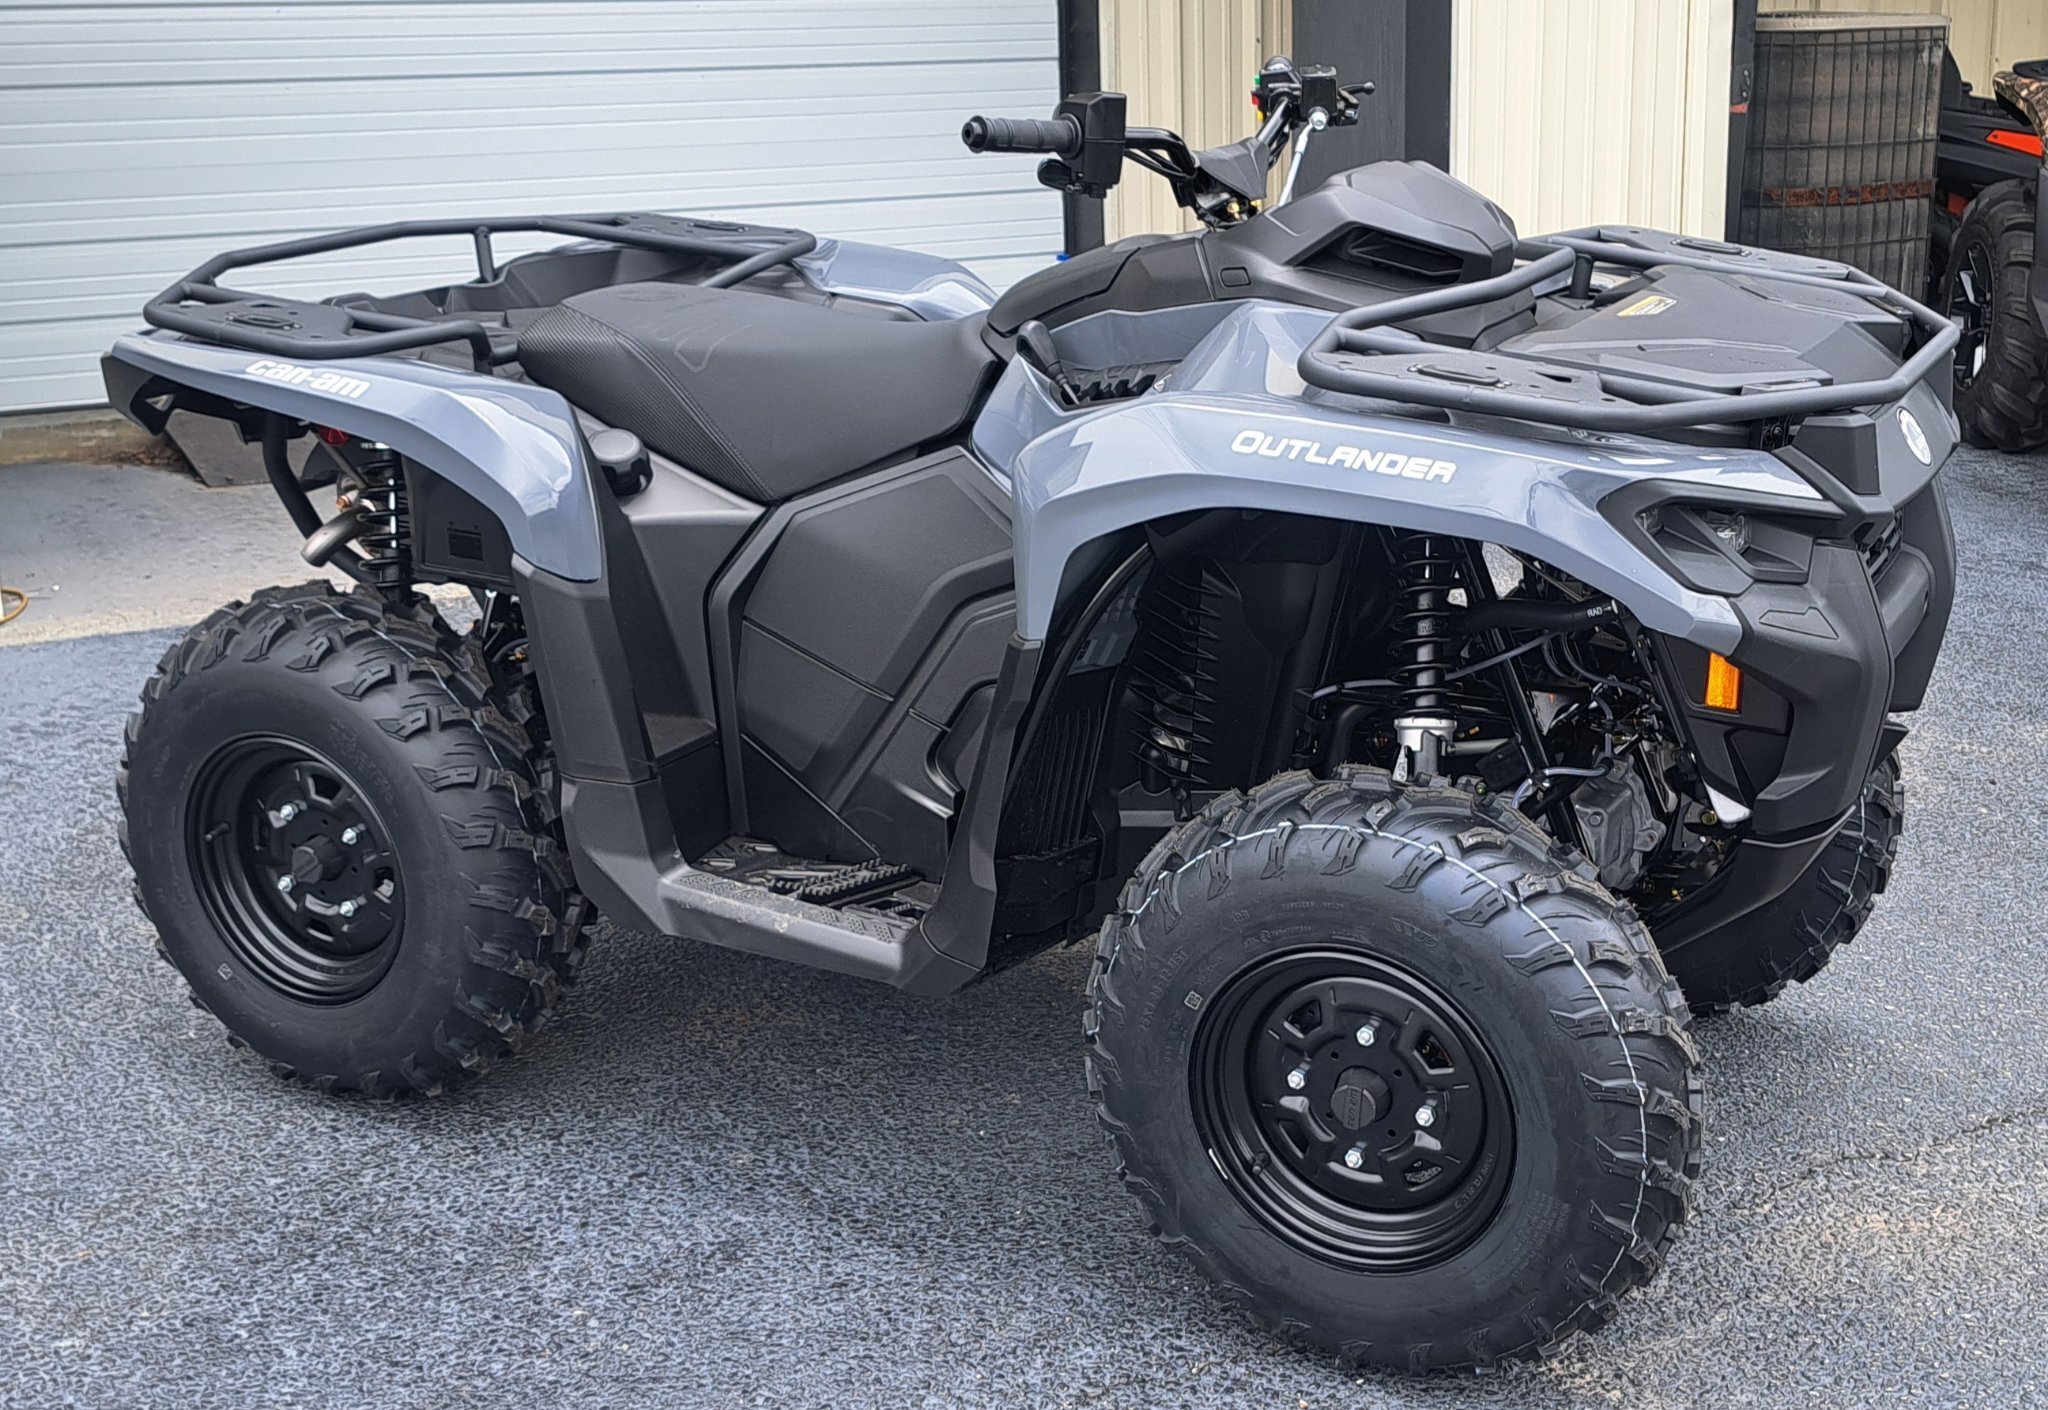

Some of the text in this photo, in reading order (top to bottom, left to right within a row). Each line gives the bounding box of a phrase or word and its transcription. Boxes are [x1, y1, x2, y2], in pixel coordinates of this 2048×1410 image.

[245, 360, 371, 399] can-am
[1231, 430, 1457, 484] OUTLANDER
[1587, 606, 1602, 618] RAD
